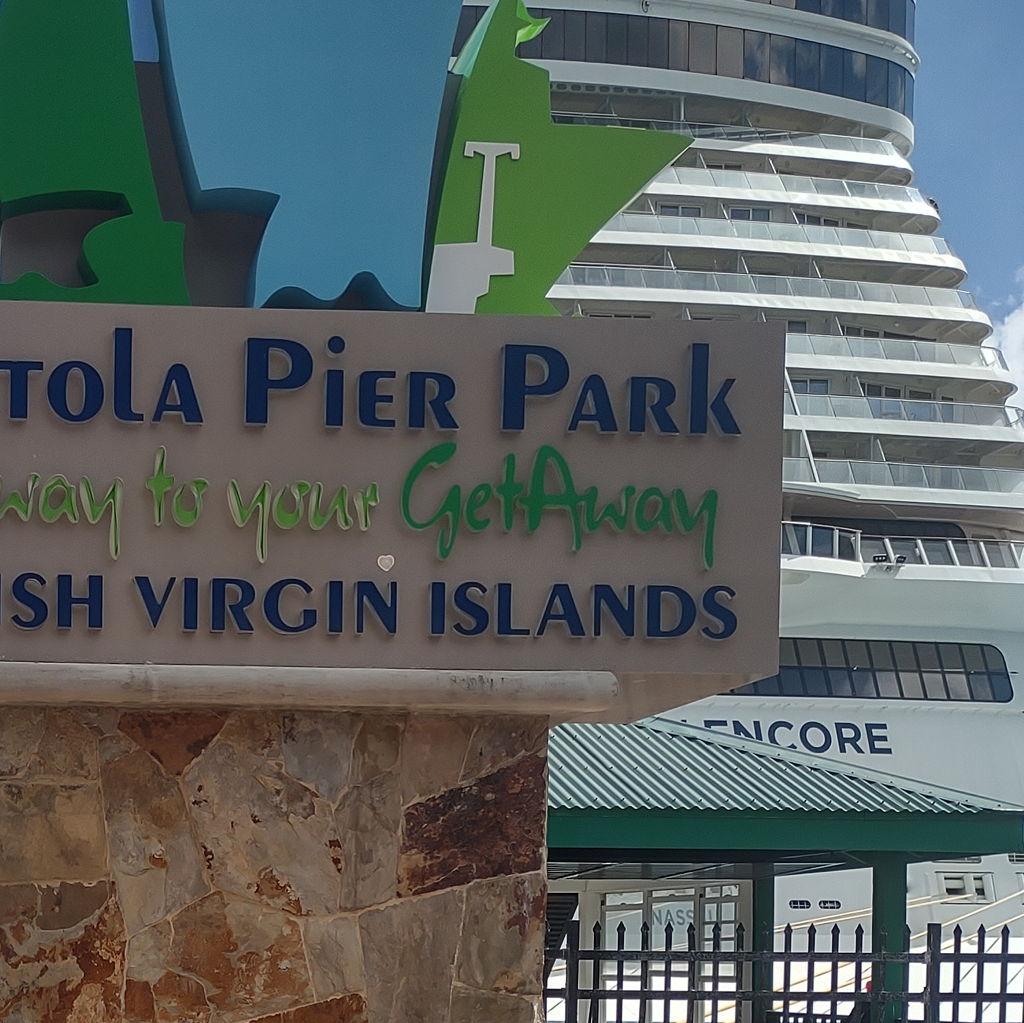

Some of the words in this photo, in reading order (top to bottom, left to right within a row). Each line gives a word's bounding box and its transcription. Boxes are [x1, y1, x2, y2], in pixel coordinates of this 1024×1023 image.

[145, 446, 209, 527] to
[227, 478, 379, 564] your
[401, 442, 719, 570] GetAway
[133, 576, 398, 637] VIRGIN
[429, 581, 739, 641] ISLANDS
[704, 720, 893, 755] NCORE
